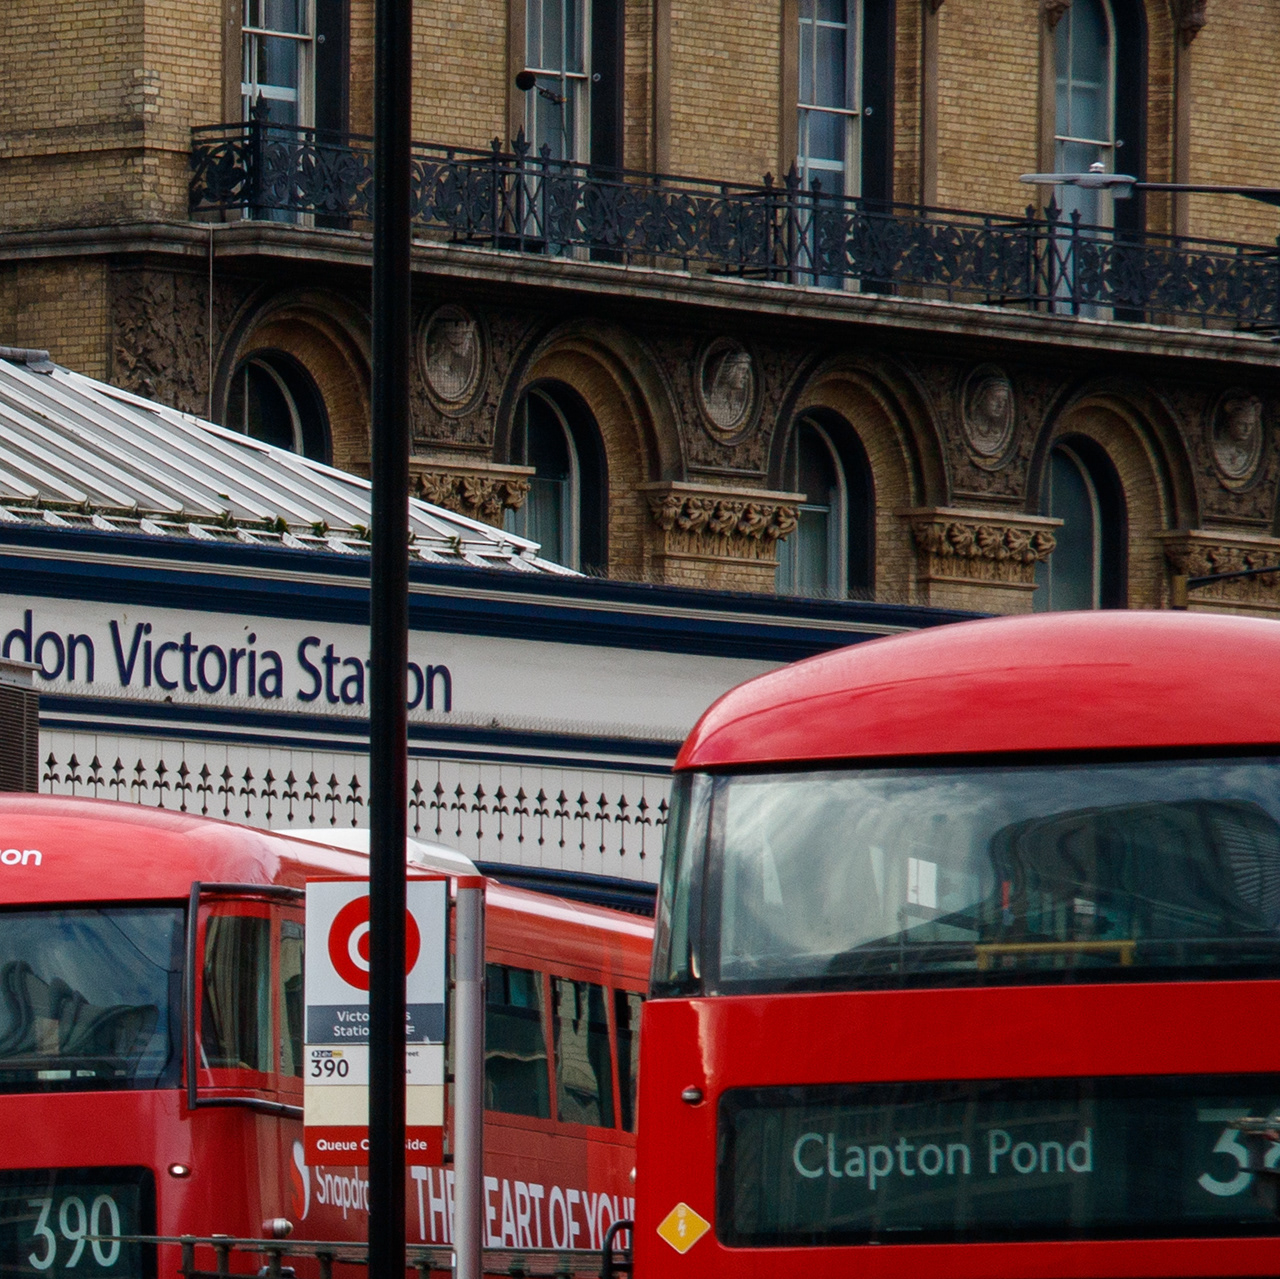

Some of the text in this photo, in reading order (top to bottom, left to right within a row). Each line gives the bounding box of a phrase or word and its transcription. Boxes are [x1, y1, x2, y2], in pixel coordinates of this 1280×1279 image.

[110, 619, 283, 699] Victoria
[297, 636, 453, 713] Staon
[311, 1059, 349, 1078] 390
[316, 1138, 358, 1151] Queue
[792, 1108, 1280, 1196] Clapton Pond 3
[28, 1193, 123, 1271] 390
[482, 1176, 544, 1249] EART
[549, 1185, 579, 1249] OF
